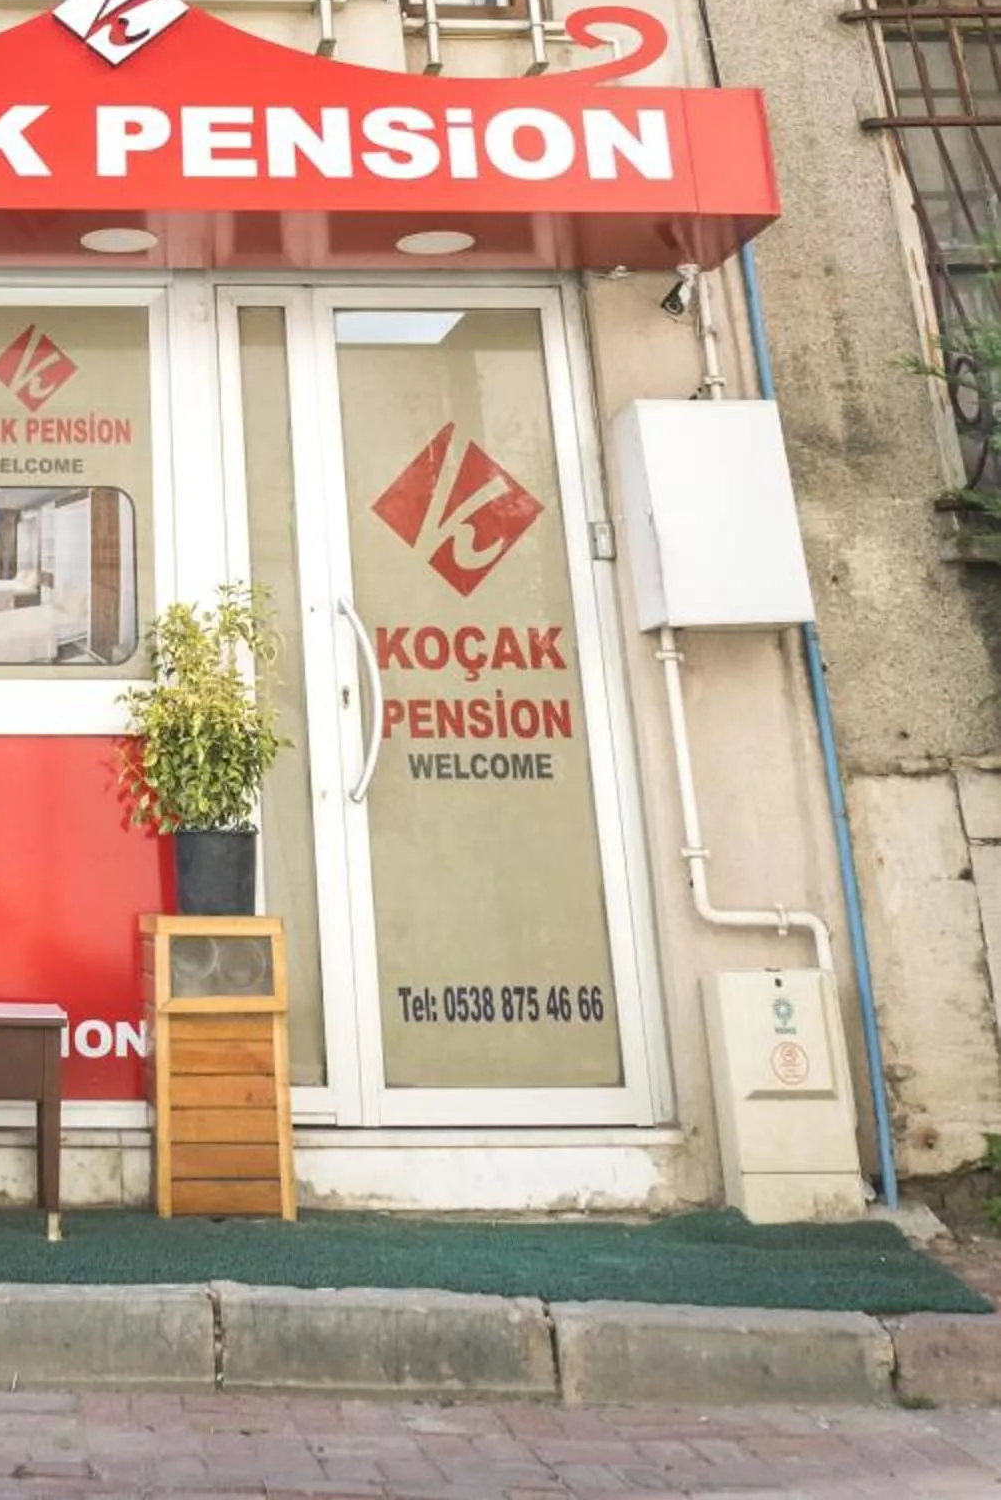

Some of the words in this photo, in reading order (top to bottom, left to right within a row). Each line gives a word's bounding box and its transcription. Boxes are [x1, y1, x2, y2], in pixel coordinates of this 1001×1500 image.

[375, 625, 568, 682] KOÇAK
[408, 752, 555, 780] WELCOME
[397, 986, 439, 1023] Tel:
[443, 984, 496, 1023] 0538
[500, 984, 540, 1023] 875
[546, 984, 572, 1023] 46
[578, 984, 605, 1023] 66
